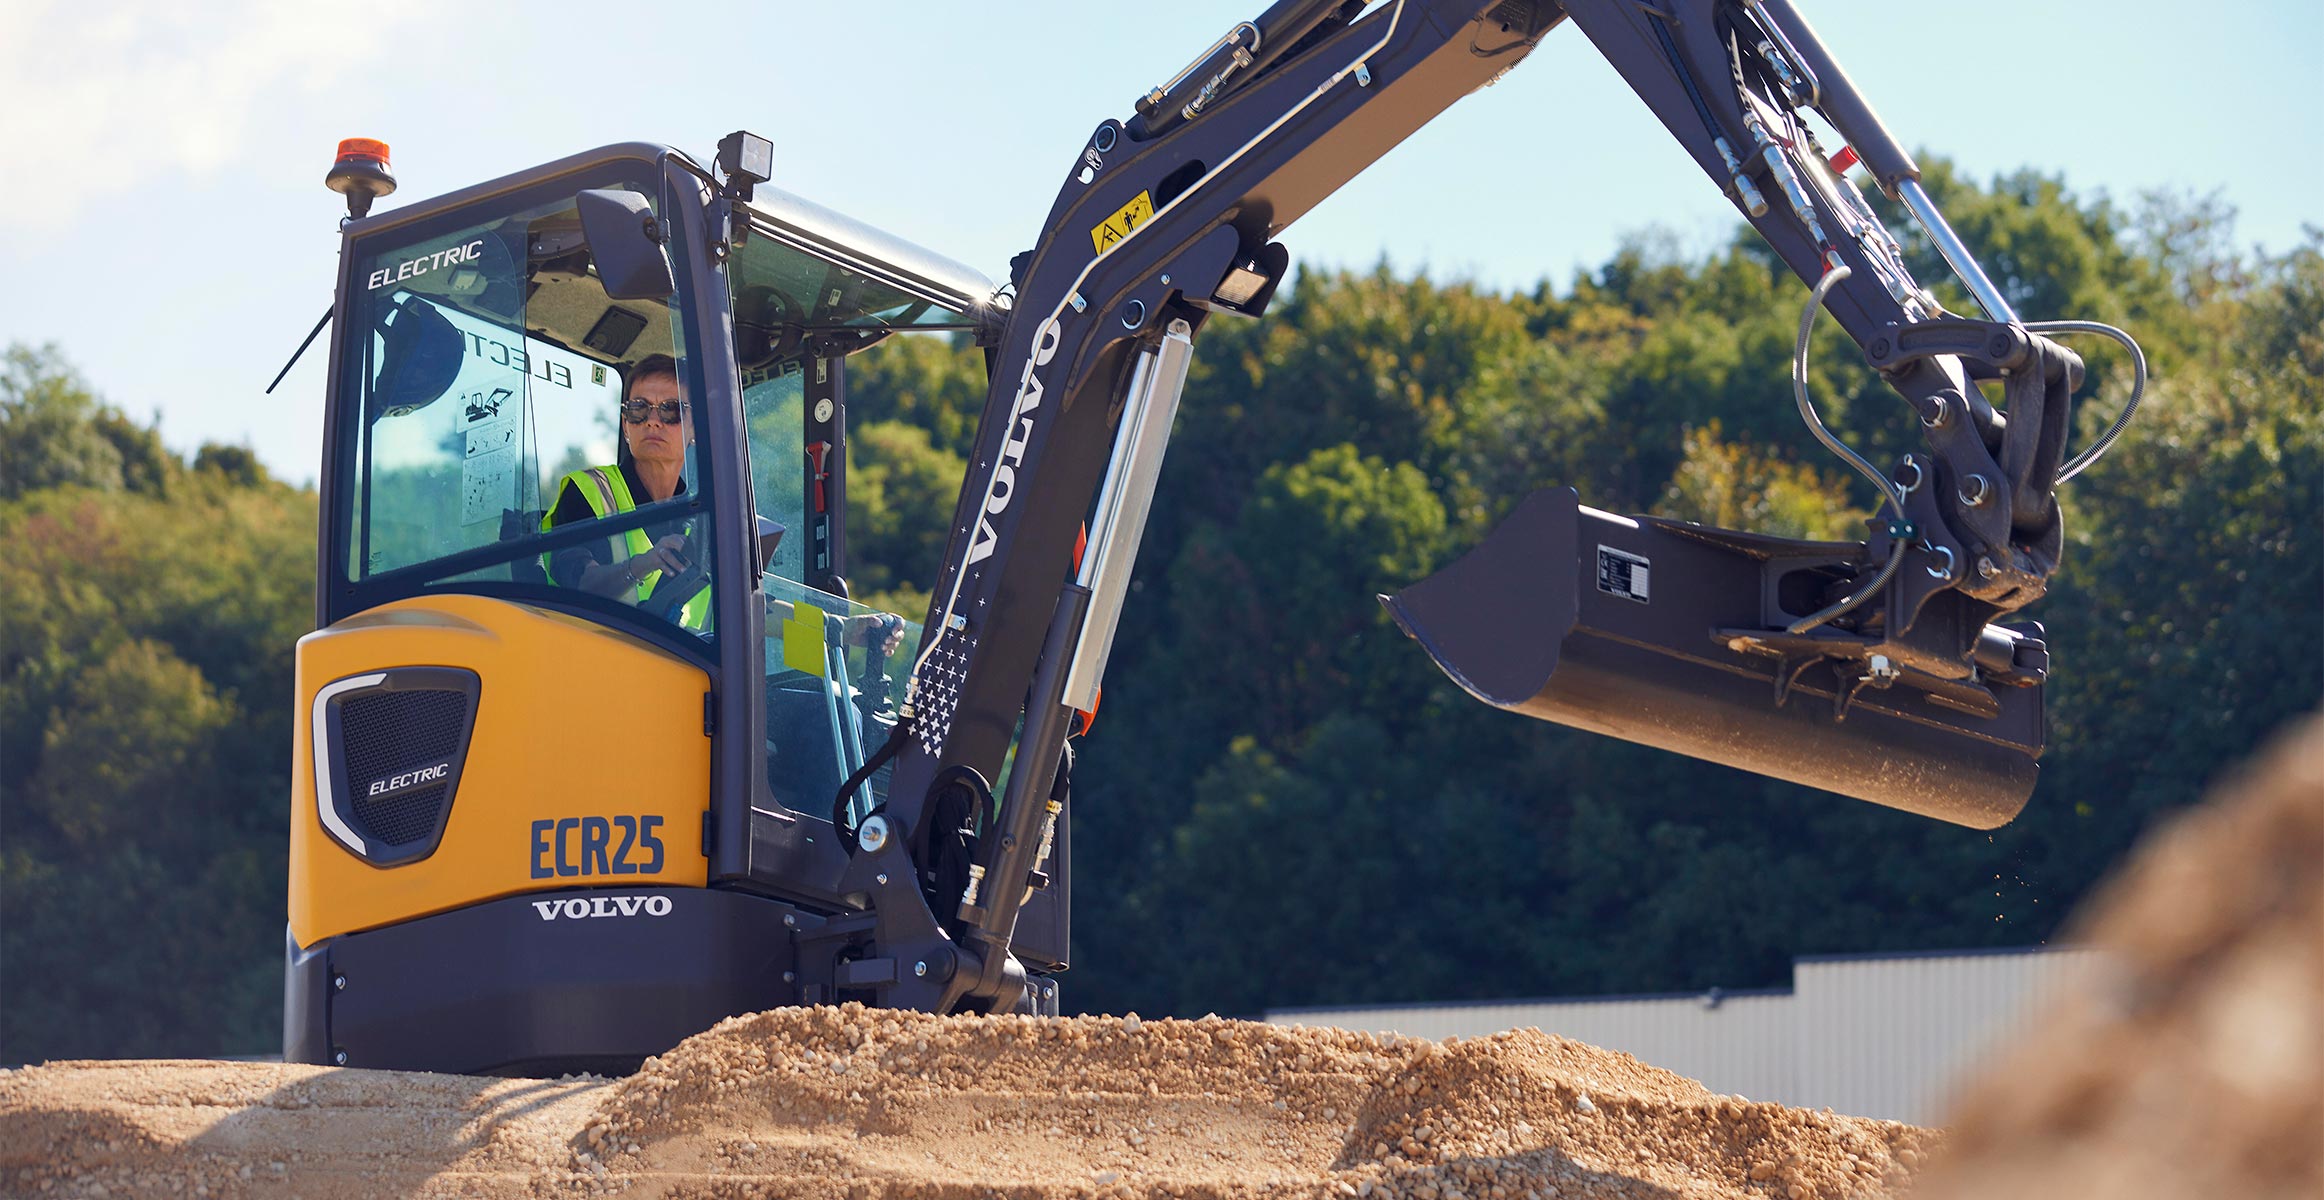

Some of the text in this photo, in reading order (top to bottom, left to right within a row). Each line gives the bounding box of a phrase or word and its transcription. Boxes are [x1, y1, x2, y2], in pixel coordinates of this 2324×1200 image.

[367, 239, 483, 291] ELECTRIC
[968, 316, 1061, 565] VOLVO
[369, 763, 448, 796] ELECTRIC
[530, 815, 664, 879] ECR25
[532, 895, 672, 921] VOLVO
